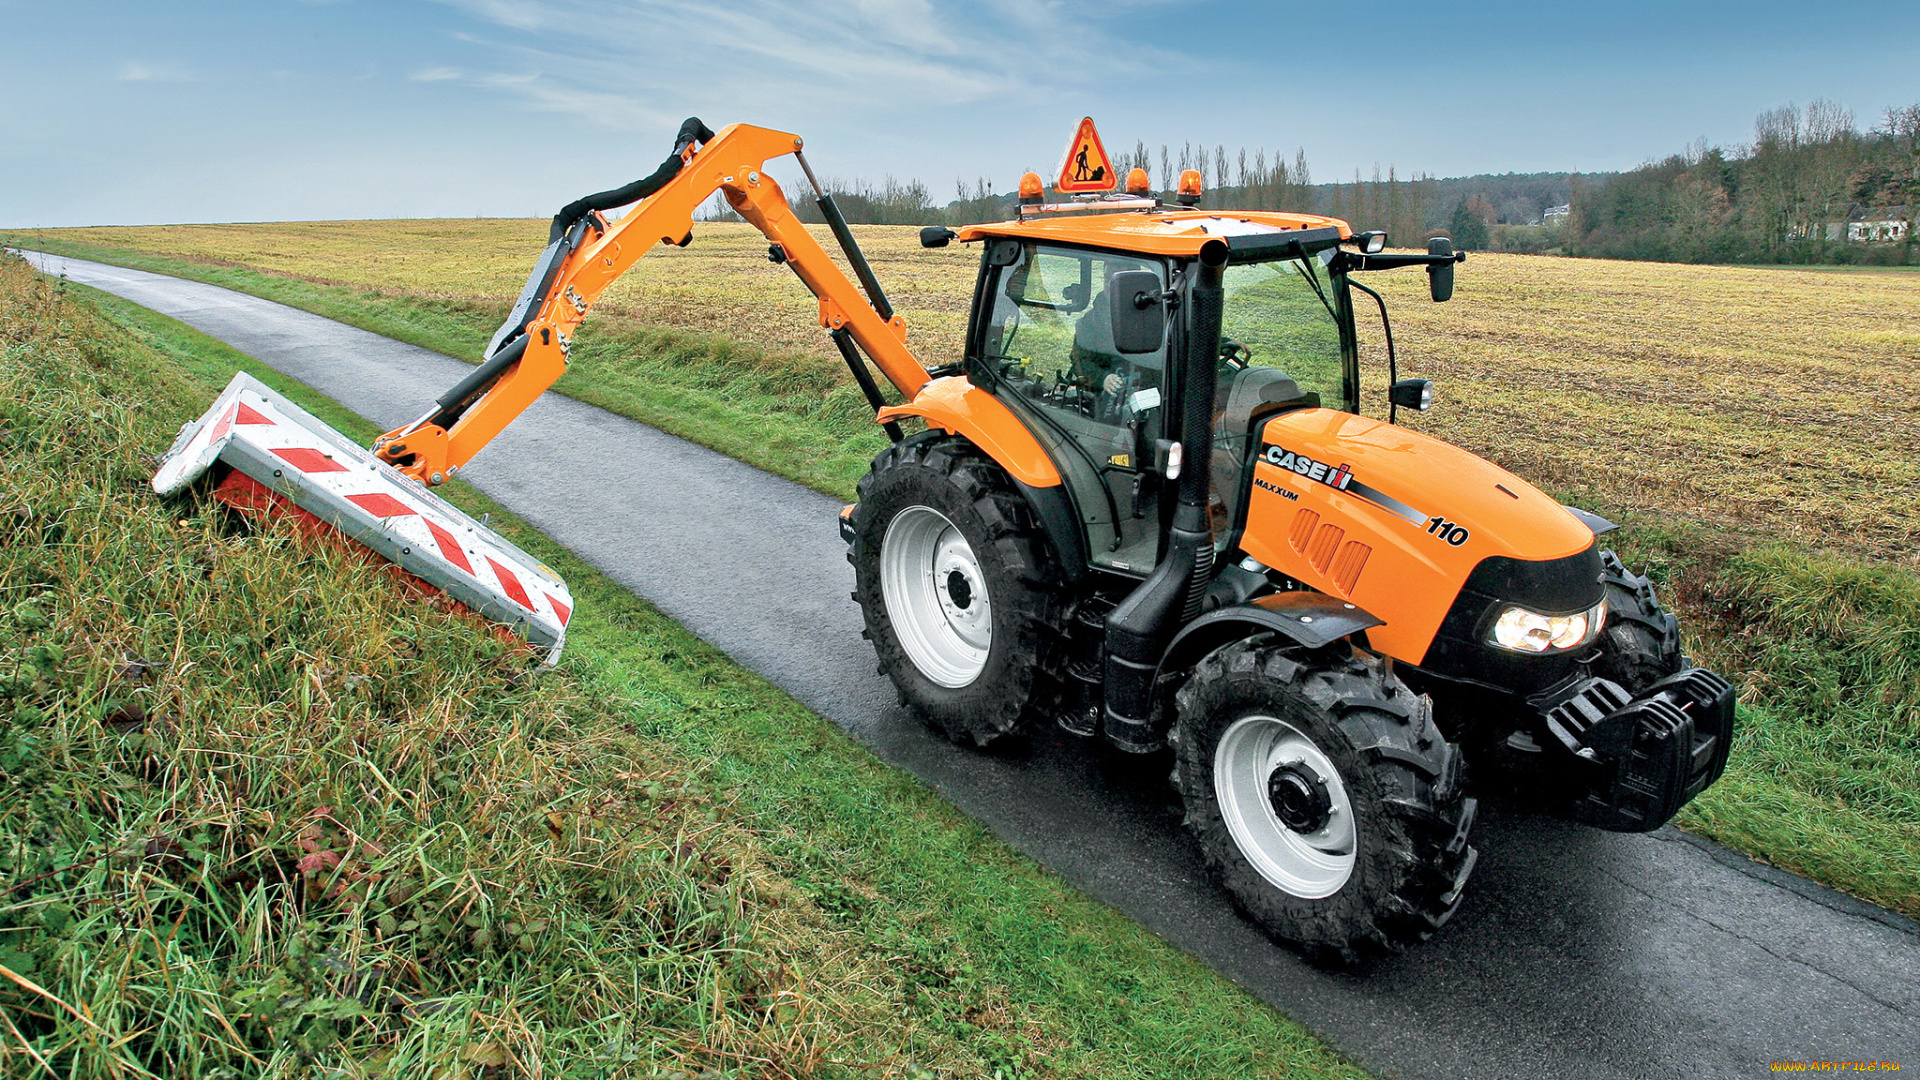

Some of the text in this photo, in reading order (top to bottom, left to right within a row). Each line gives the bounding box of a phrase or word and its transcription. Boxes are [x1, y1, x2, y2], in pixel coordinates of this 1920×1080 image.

[1266, 445, 1328, 482] CASE
[1254, 478, 1299, 502] MAXXUM
[1427, 517, 1469, 547] 110
